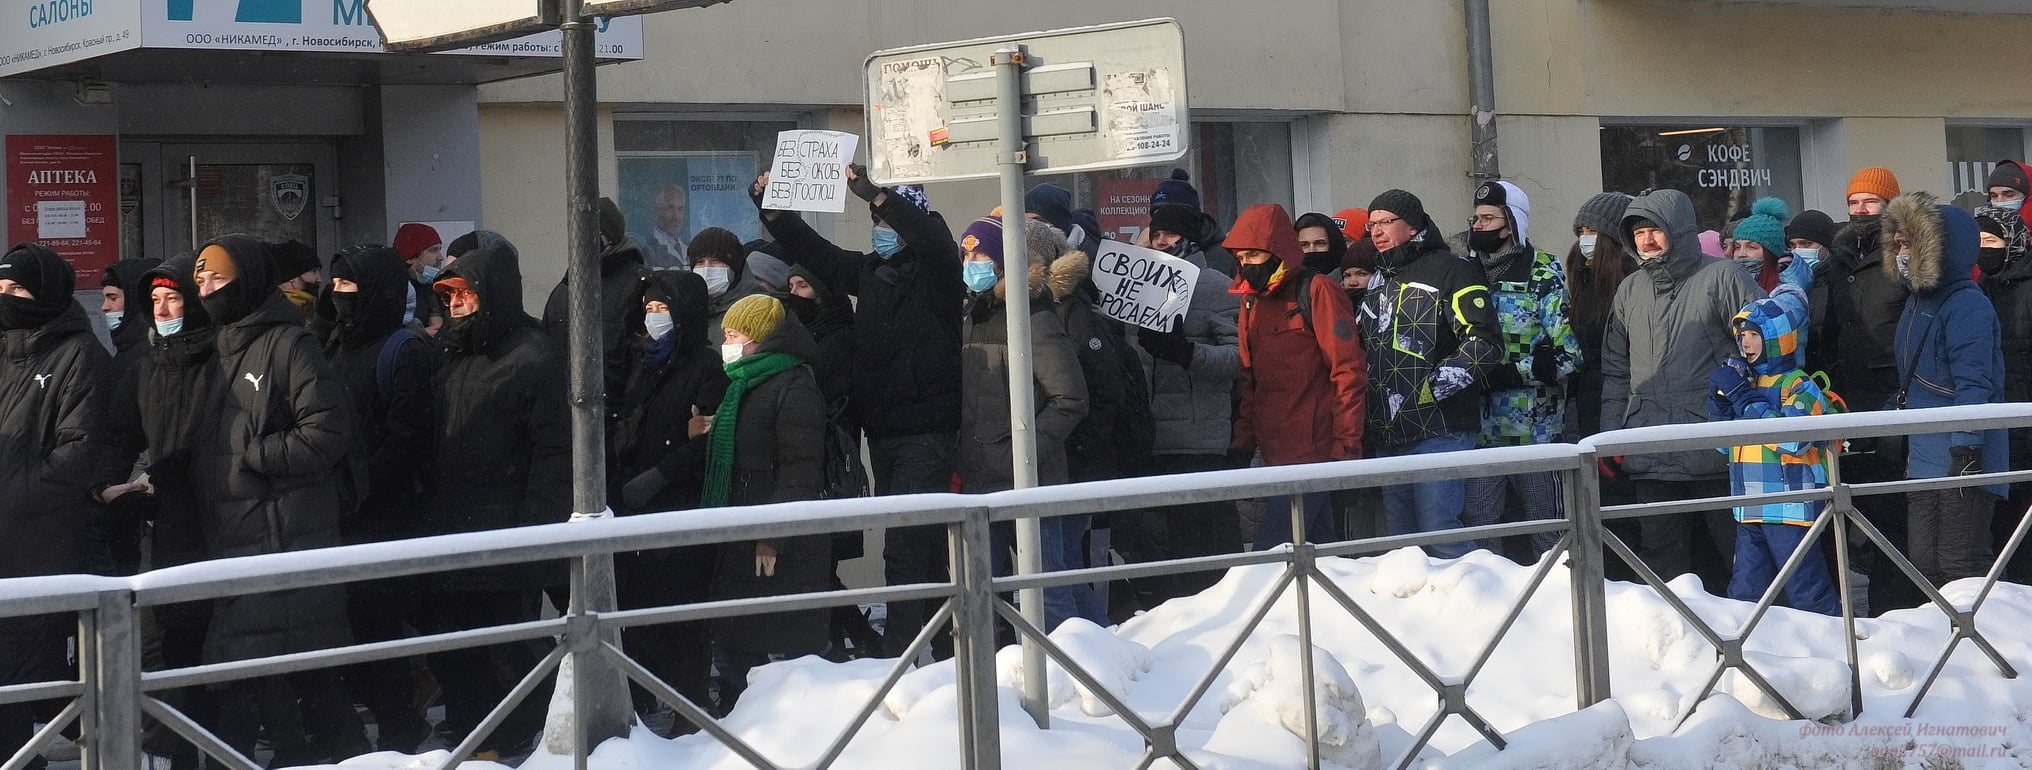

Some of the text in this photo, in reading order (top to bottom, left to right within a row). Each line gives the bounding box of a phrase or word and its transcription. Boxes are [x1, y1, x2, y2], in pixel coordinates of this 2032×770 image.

[30, 0, 93, 28] САЛОНЫ
[82, 34, 104, 48] Красный
[122, 29, 130, 39] 49
[186, 33, 212, 44] ООО
[303, 36, 376, 48] Новосибирск,
[512, 42, 552, 53] работы:
[599, 45, 623, 54] 21.00
[778, 140, 839, 158] БЕЗ СТРАХА
[1708, 144, 1751, 163] КОФЕ
[28, 169, 97, 184] АПТЕКА
[781, 161, 840, 180] БЕЗ ОКОВ
[1698, 168, 1771, 190] СЭНДВИЧ
[771, 181, 835, 201] БЕЗ ГОСПОД
[1110, 195, 1121, 204] НА
[1122, 195, 1152, 204] СЕЗОНН
[22, 217, 35, 225] БЕЗ
[87, 216, 105, 224] ОБЕД
[1100, 206, 1147, 217] КОЛЛЕКЦИЮ
[1098, 252, 1182, 293] СВОИХ
[1115, 277, 1144, 301] НЕ
